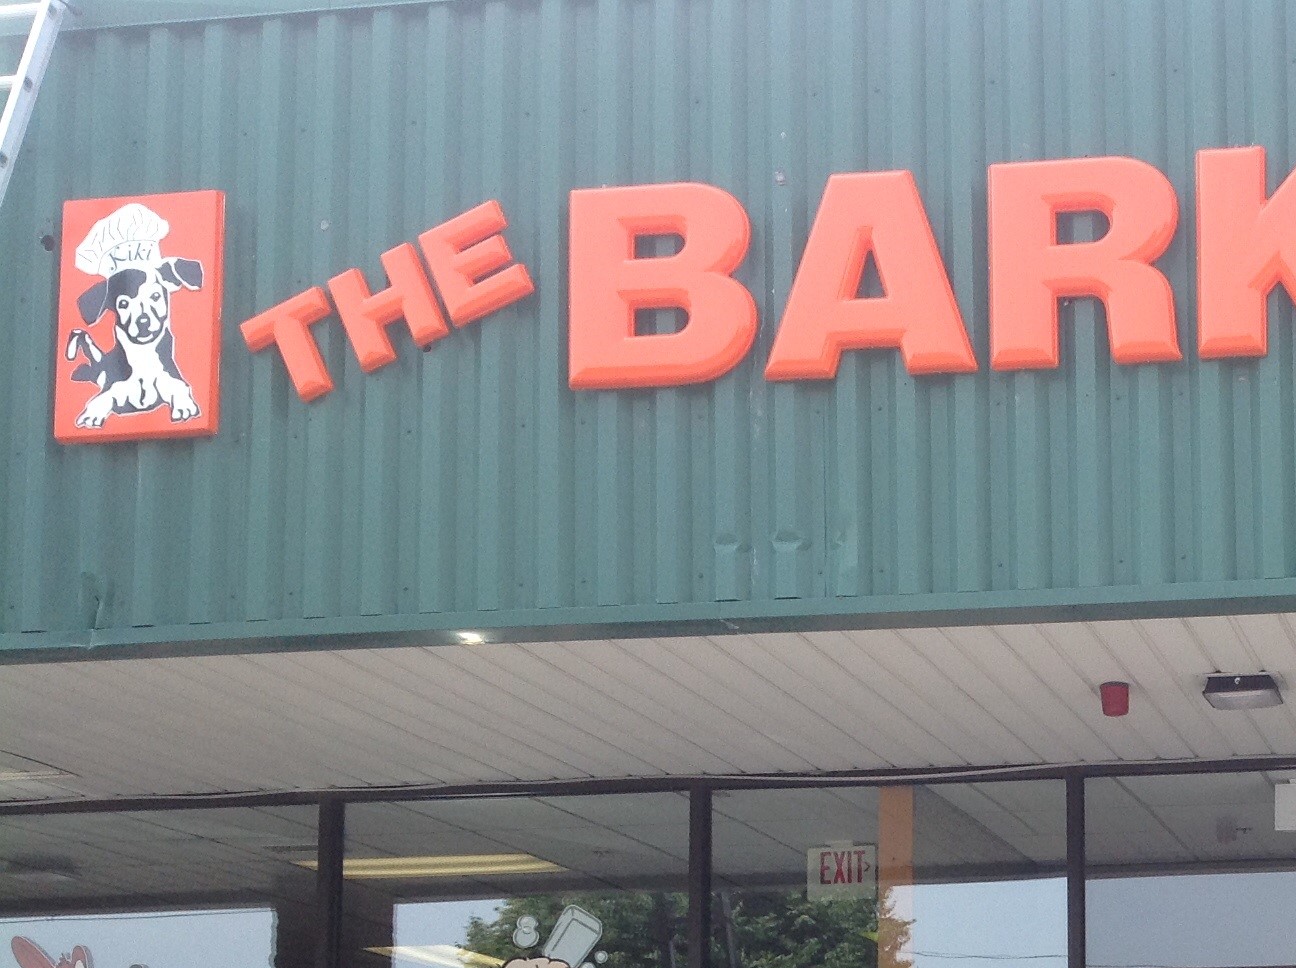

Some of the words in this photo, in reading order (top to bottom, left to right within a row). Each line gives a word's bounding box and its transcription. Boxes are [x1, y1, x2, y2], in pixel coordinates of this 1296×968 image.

[109, 242, 152, 270] Kiki
[240, 200, 534, 401] THE
[820, 850, 865, 884] EXIT
